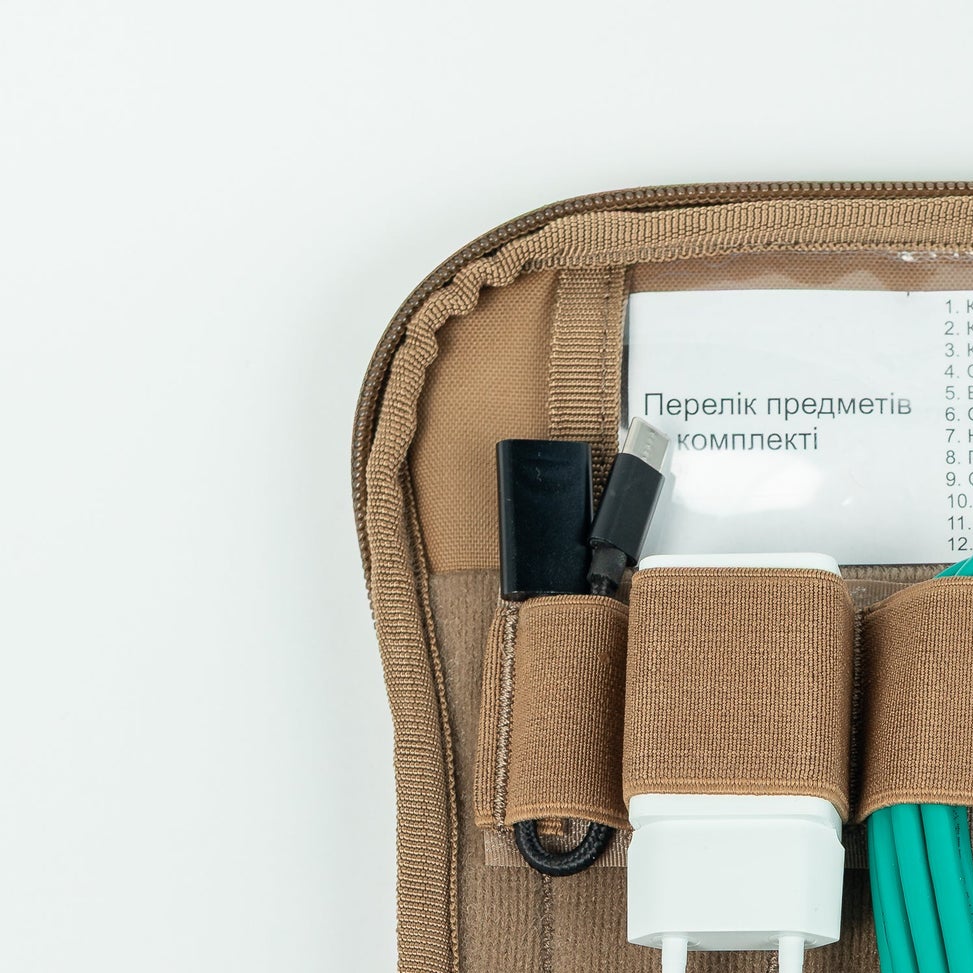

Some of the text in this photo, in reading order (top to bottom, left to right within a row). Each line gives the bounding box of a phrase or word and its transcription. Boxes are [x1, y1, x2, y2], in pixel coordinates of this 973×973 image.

[946, 300, 958, 313] 1.
[945, 321, 959, 335] 2.
[945, 343, 959, 357] 3.
[944, 365, 959, 378] 4.
[946, 386, 960, 400] 5.
[644, 391, 911, 421] Перелік предметів
[945, 407, 960, 421] 6.
[677, 426, 819, 451] комплекті
[946, 429, 960, 443] 7.
[946, 450, 960, 464] 8.
[946, 472, 960, 486] 9.
[948, 493, 972, 508] 10.
[948, 516, 971, 530] 11.
[948, 537, 973, 551] 12.
